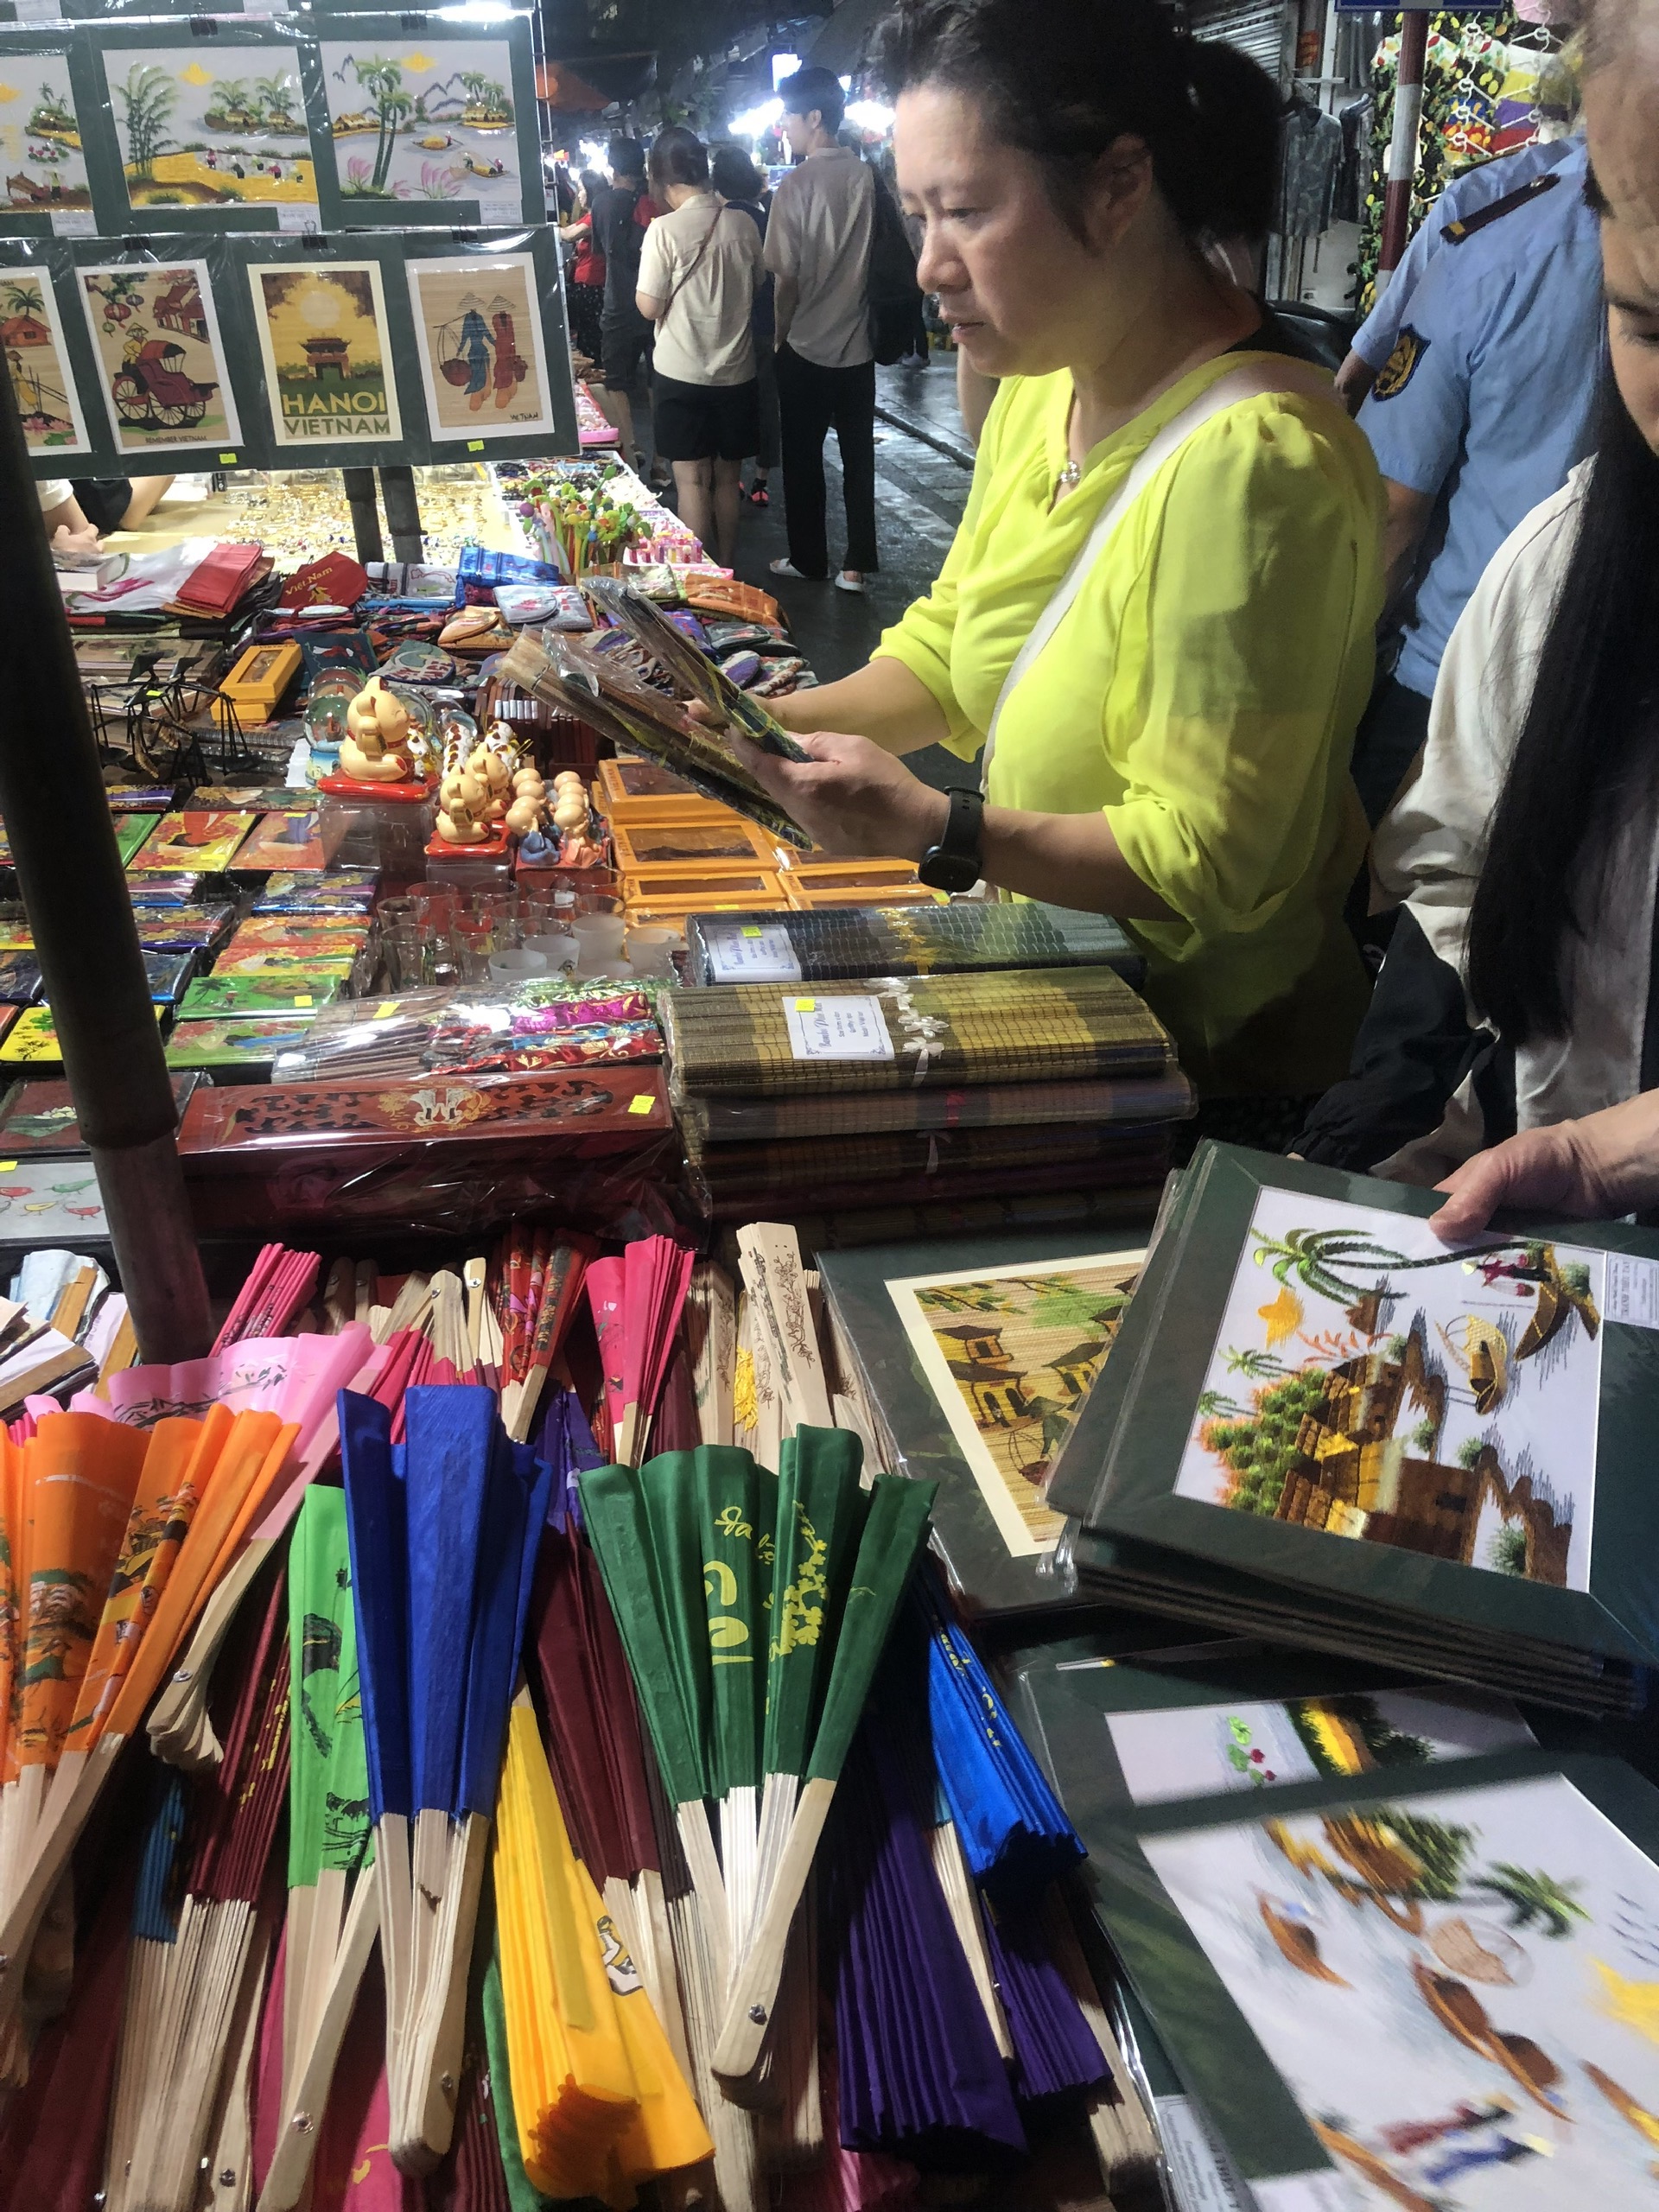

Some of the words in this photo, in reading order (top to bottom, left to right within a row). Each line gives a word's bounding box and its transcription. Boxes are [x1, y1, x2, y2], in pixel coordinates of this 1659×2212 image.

[282, 391, 386, 415] HANOI
[283, 418, 390, 435] VIETNAM
[307, 567, 333, 583] Nam
